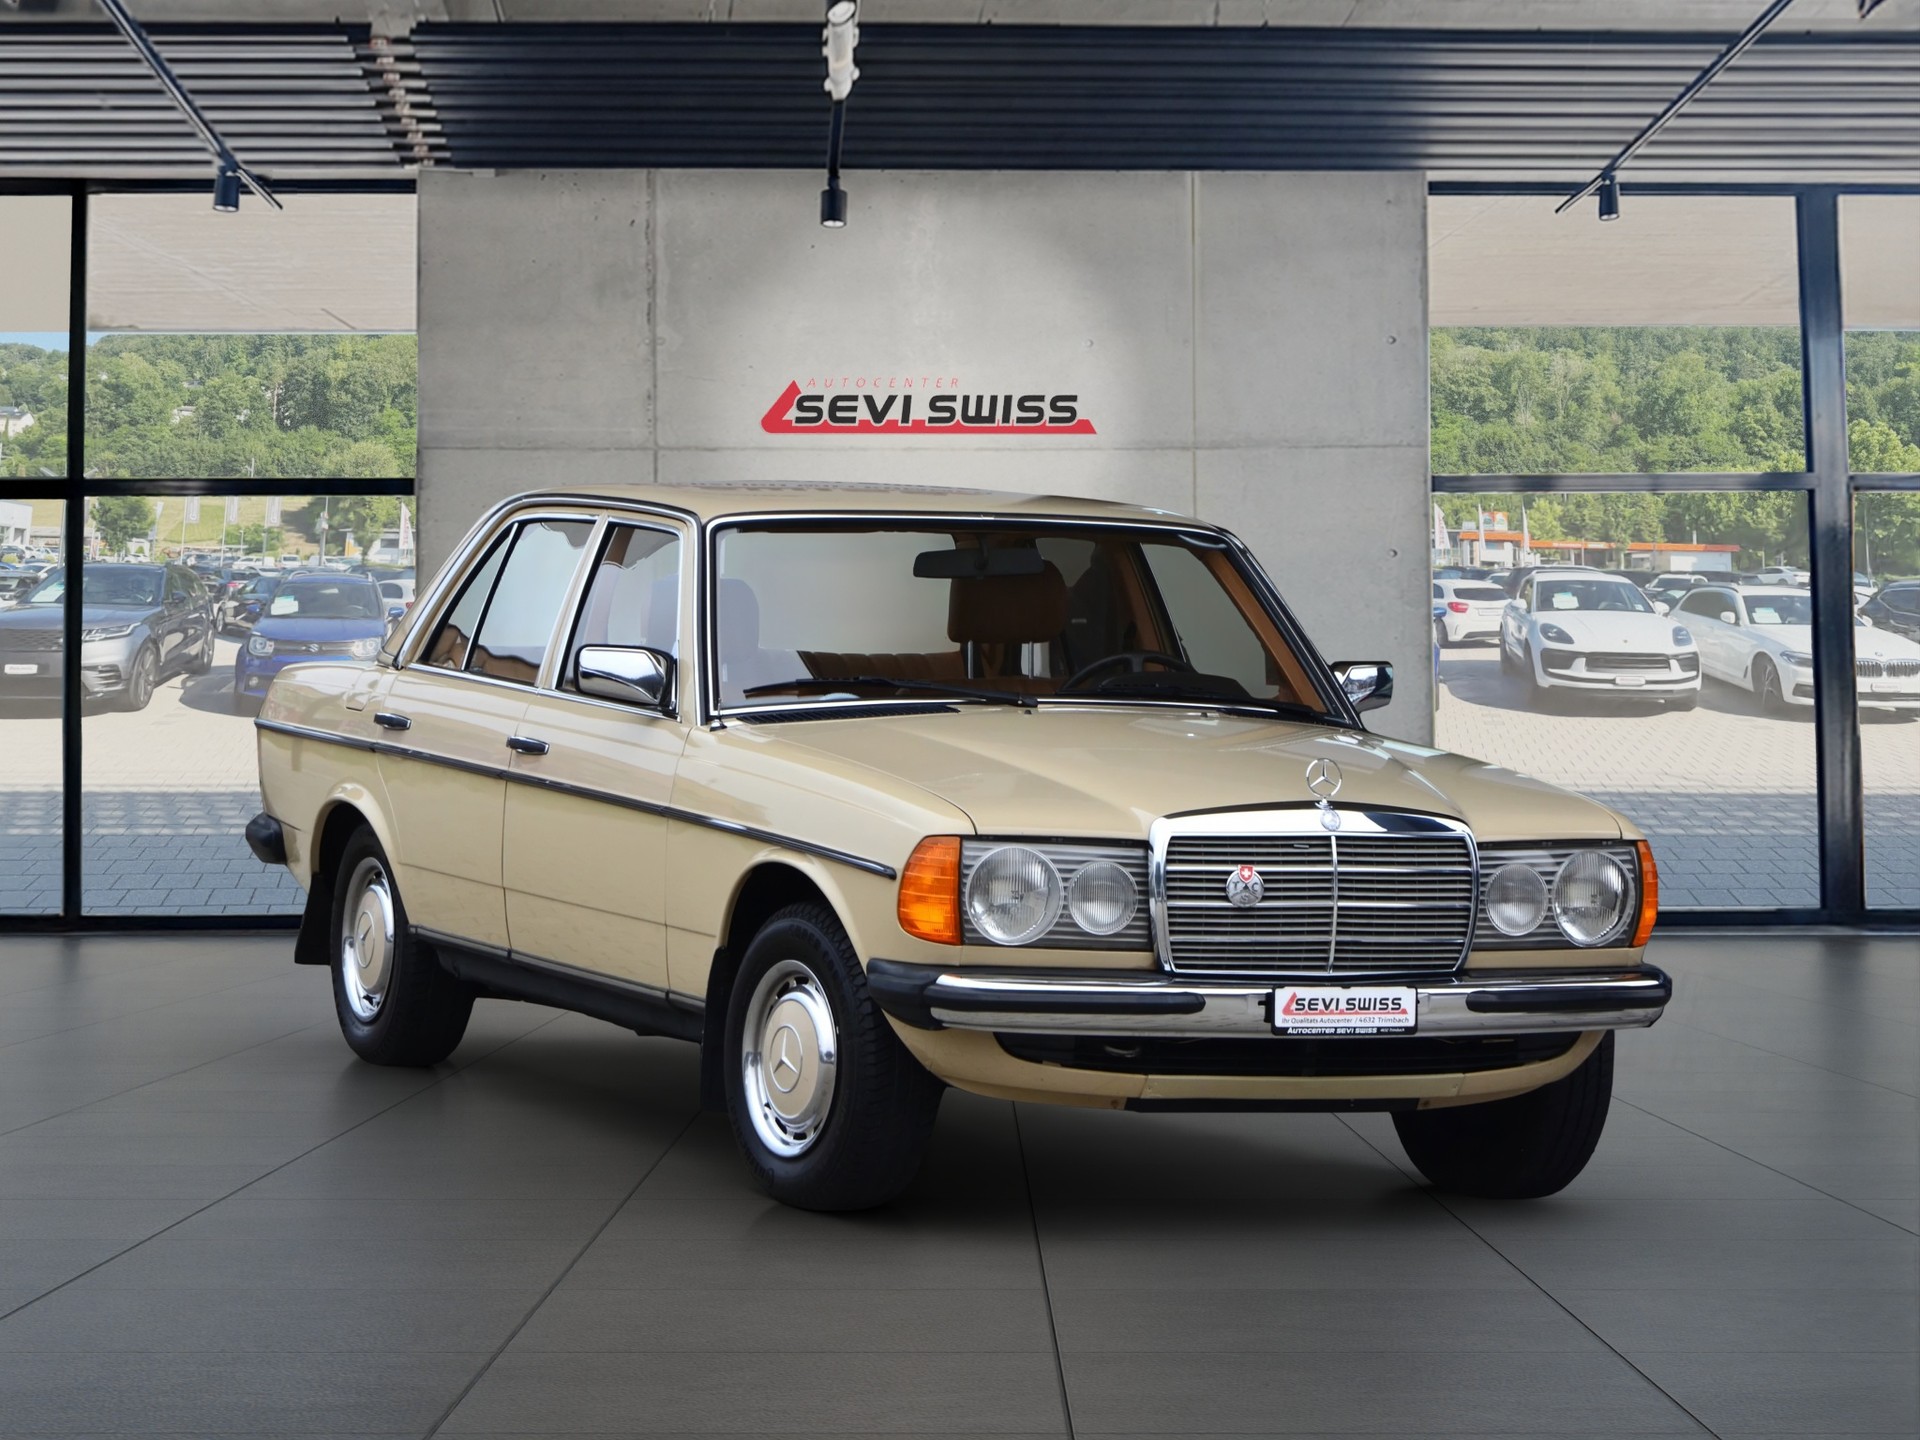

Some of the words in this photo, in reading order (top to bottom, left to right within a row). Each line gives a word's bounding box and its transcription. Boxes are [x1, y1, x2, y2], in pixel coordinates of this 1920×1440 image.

[806, 377, 960, 389] AUTOCENTER
[794, 394, 912, 425] SEVI
[927, 394, 1078, 425] SWISS
[1295, 998, 1339, 1011] SEVI
[1346, 998, 1402, 1011] SWISS
[1319, 1017, 1353, 1025] Autocenter
